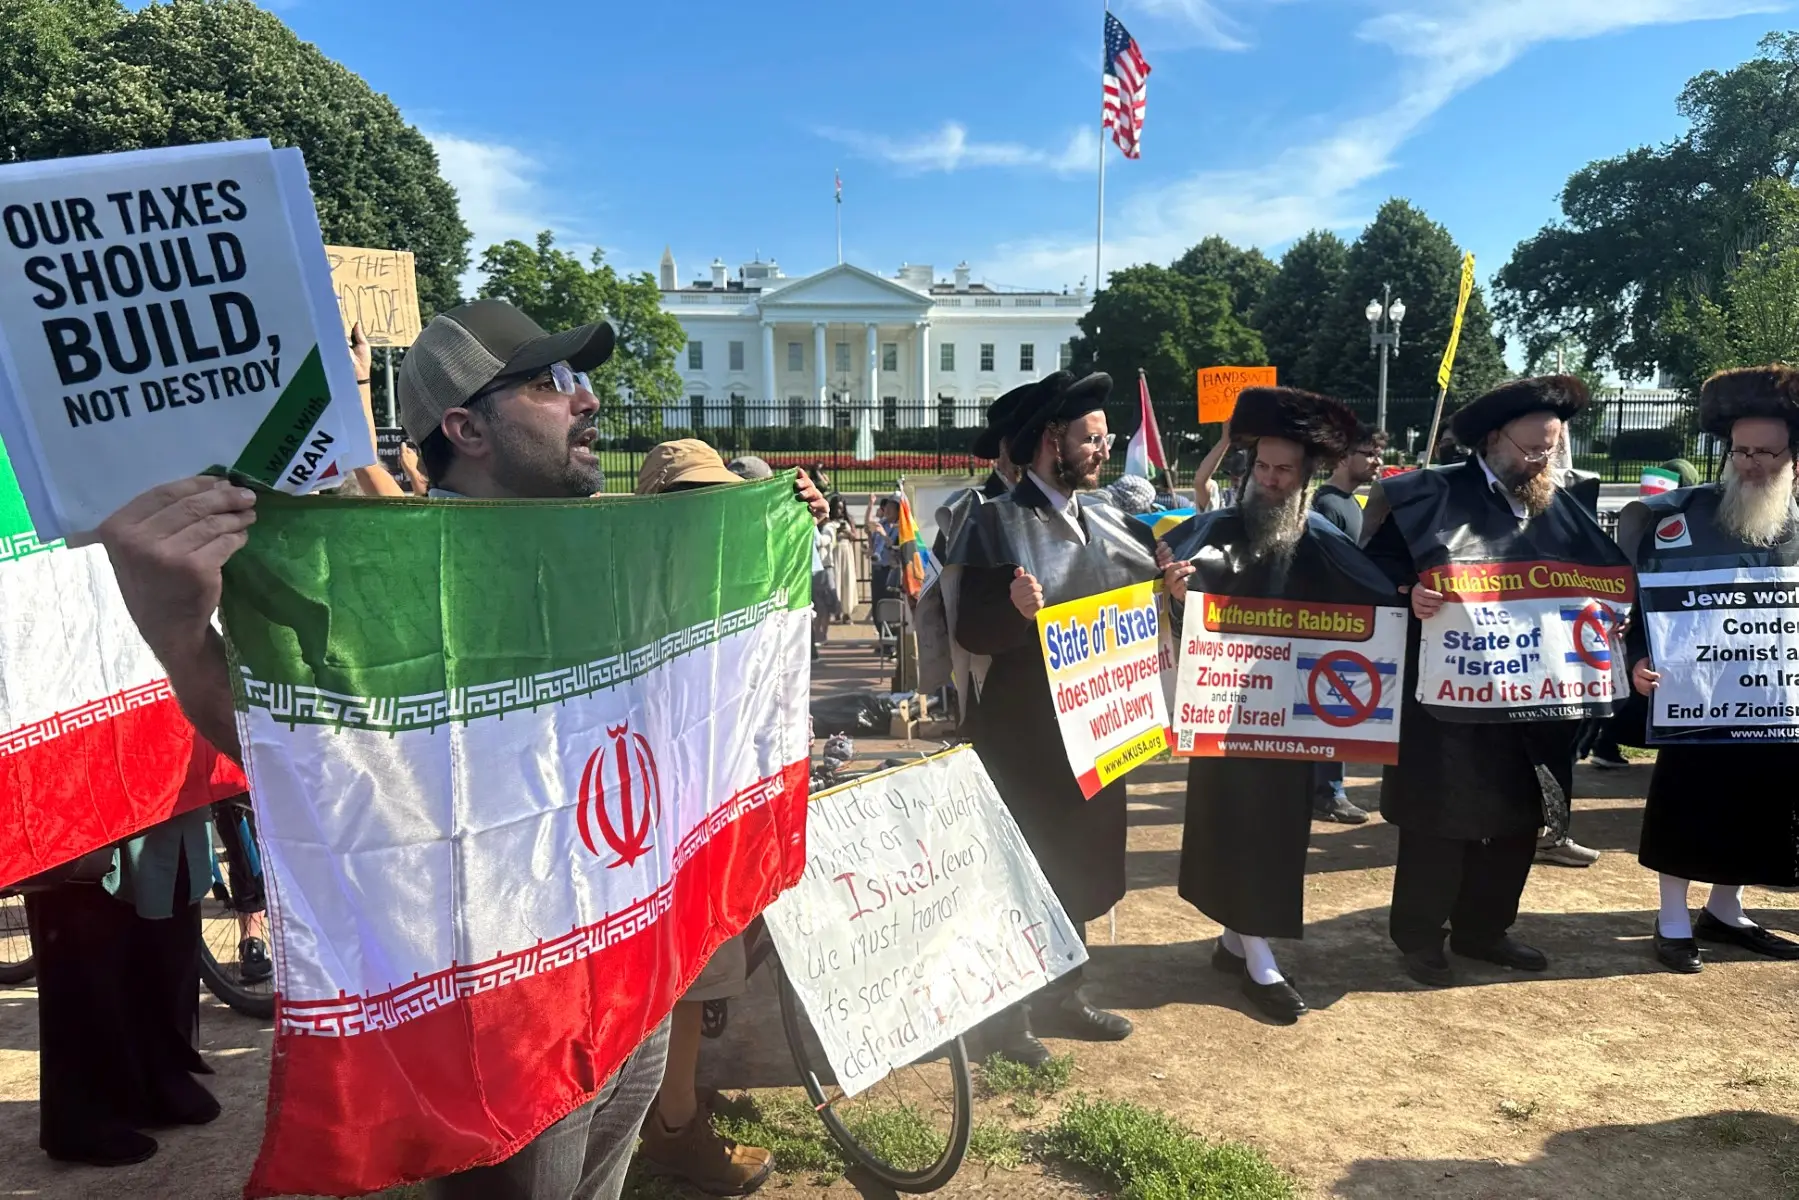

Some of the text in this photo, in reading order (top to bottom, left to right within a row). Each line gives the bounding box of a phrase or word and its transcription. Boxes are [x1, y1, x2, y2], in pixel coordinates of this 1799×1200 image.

[3, 180, 247, 249] OUR TAXES
[24, 232, 246, 310] SHOULD
[350, 254, 394, 280] THE
[42, 291, 280, 386] BUILD,
[63, 357, 281, 428] NOT DESTROY
[1203, 371, 1247, 388] HANDS
[1224, 386, 1243, 399] OF
[265, 434, 298, 472] WAR
[286, 430, 335, 486] IRAN
[1431, 565, 1626, 595] Judaism Condemns
[1681, 590, 1747, 608] Jews
[1206, 601, 1366, 634] Authentic Rabbis
[1474, 606, 1511, 626] the
[1722, 617, 1799, 635] Conde
[1045, 622, 1089, 671] State
[1092, 614, 1106, 651] of
[1188, 637, 1291, 664] always opposed
[1443, 627, 1542, 651] State of
[1696, 644, 1779, 662] Zionist
[1056, 646, 1173, 714] does not represent
[1197, 666, 1273, 690] Zionism
[1437, 679, 1494, 702] And
[1501, 680, 1532, 702] its
[1739, 673, 1768, 687] on
[1211, 691, 1247, 704] and the
[1667, 702, 1799, 719] End of Zionis
[1089, 691, 1154, 741] world Jewry
[1181, 702, 1286, 728] State of Israel
[1103, 734, 1163, 775] www.NKUSA.org
[1217, 738, 1335, 758] www.NKUSA.org
[941, 834, 988, 880] (ever)
[807, 942, 841, 980] We
[851, 911, 900, 966] must
[912, 885, 960, 934] honor
